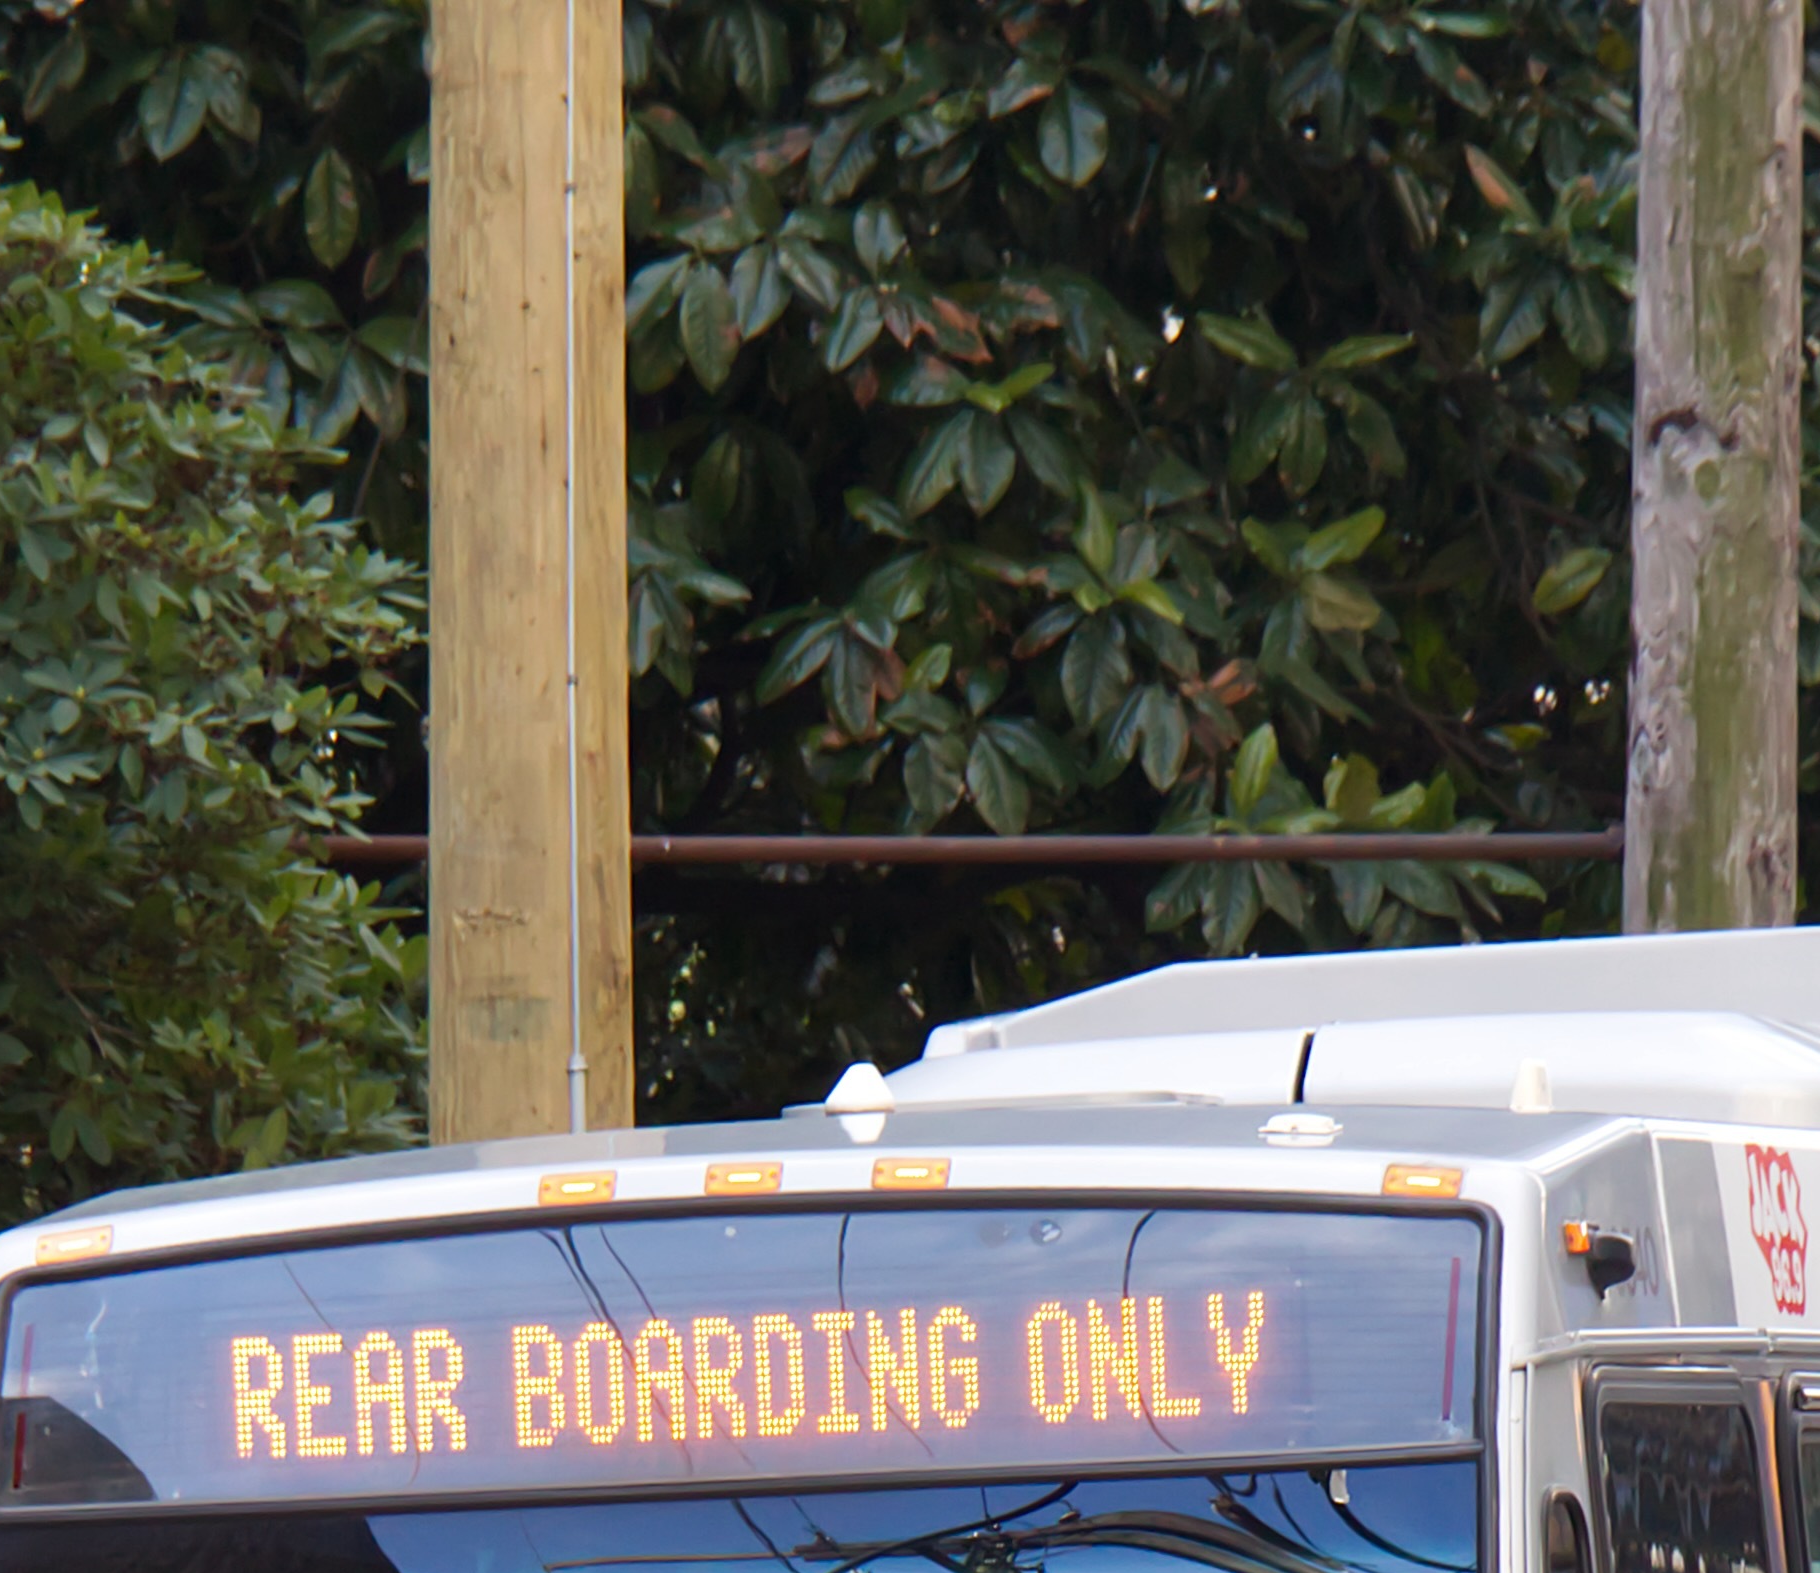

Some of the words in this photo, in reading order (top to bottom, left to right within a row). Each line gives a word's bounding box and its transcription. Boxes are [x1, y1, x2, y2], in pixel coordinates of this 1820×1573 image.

[1747, 1153, 1805, 1250] JACK
[232, 1328, 467, 1459] REAR
[512, 1306, 980, 1447] BOARDING
[1027, 1291, 1265, 1425] ONLY
